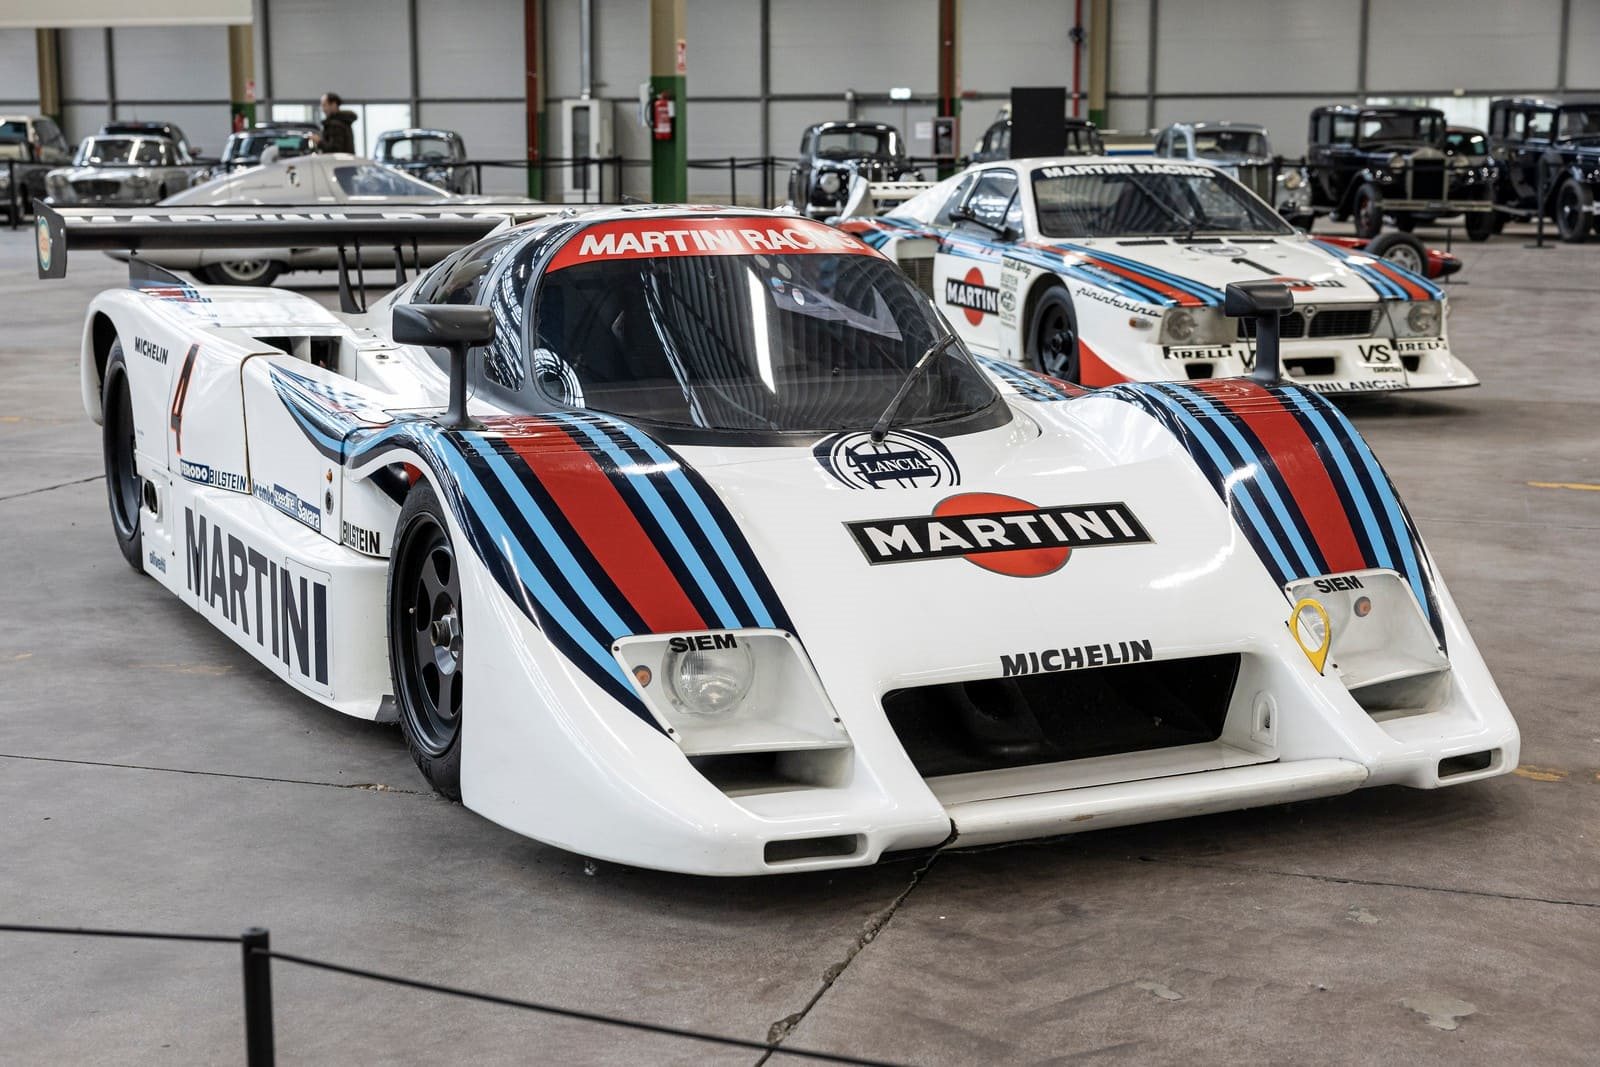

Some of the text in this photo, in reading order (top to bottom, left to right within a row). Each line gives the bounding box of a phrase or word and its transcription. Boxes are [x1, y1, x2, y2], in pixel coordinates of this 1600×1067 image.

[1041, 165, 1216, 178] MARTINI RACING
[579, 228, 866, 256] MARTINI RACING
[134, 336, 168, 365] MICHELIN
[1358, 344, 1391, 363] VS
[861, 458, 929, 473] LANCIA
[209, 469, 247, 491] BILSTEIN
[297, 499, 320, 529] Savara
[342, 520, 380, 554] BILSTEIN
[863, 508, 1137, 556] MARTINI
[185, 506, 329, 686] MARTINI
[1313, 575, 1364, 593] SIEM
[669, 633, 738, 653] SIEM
[1000, 639, 1153, 676] MICHELIN
